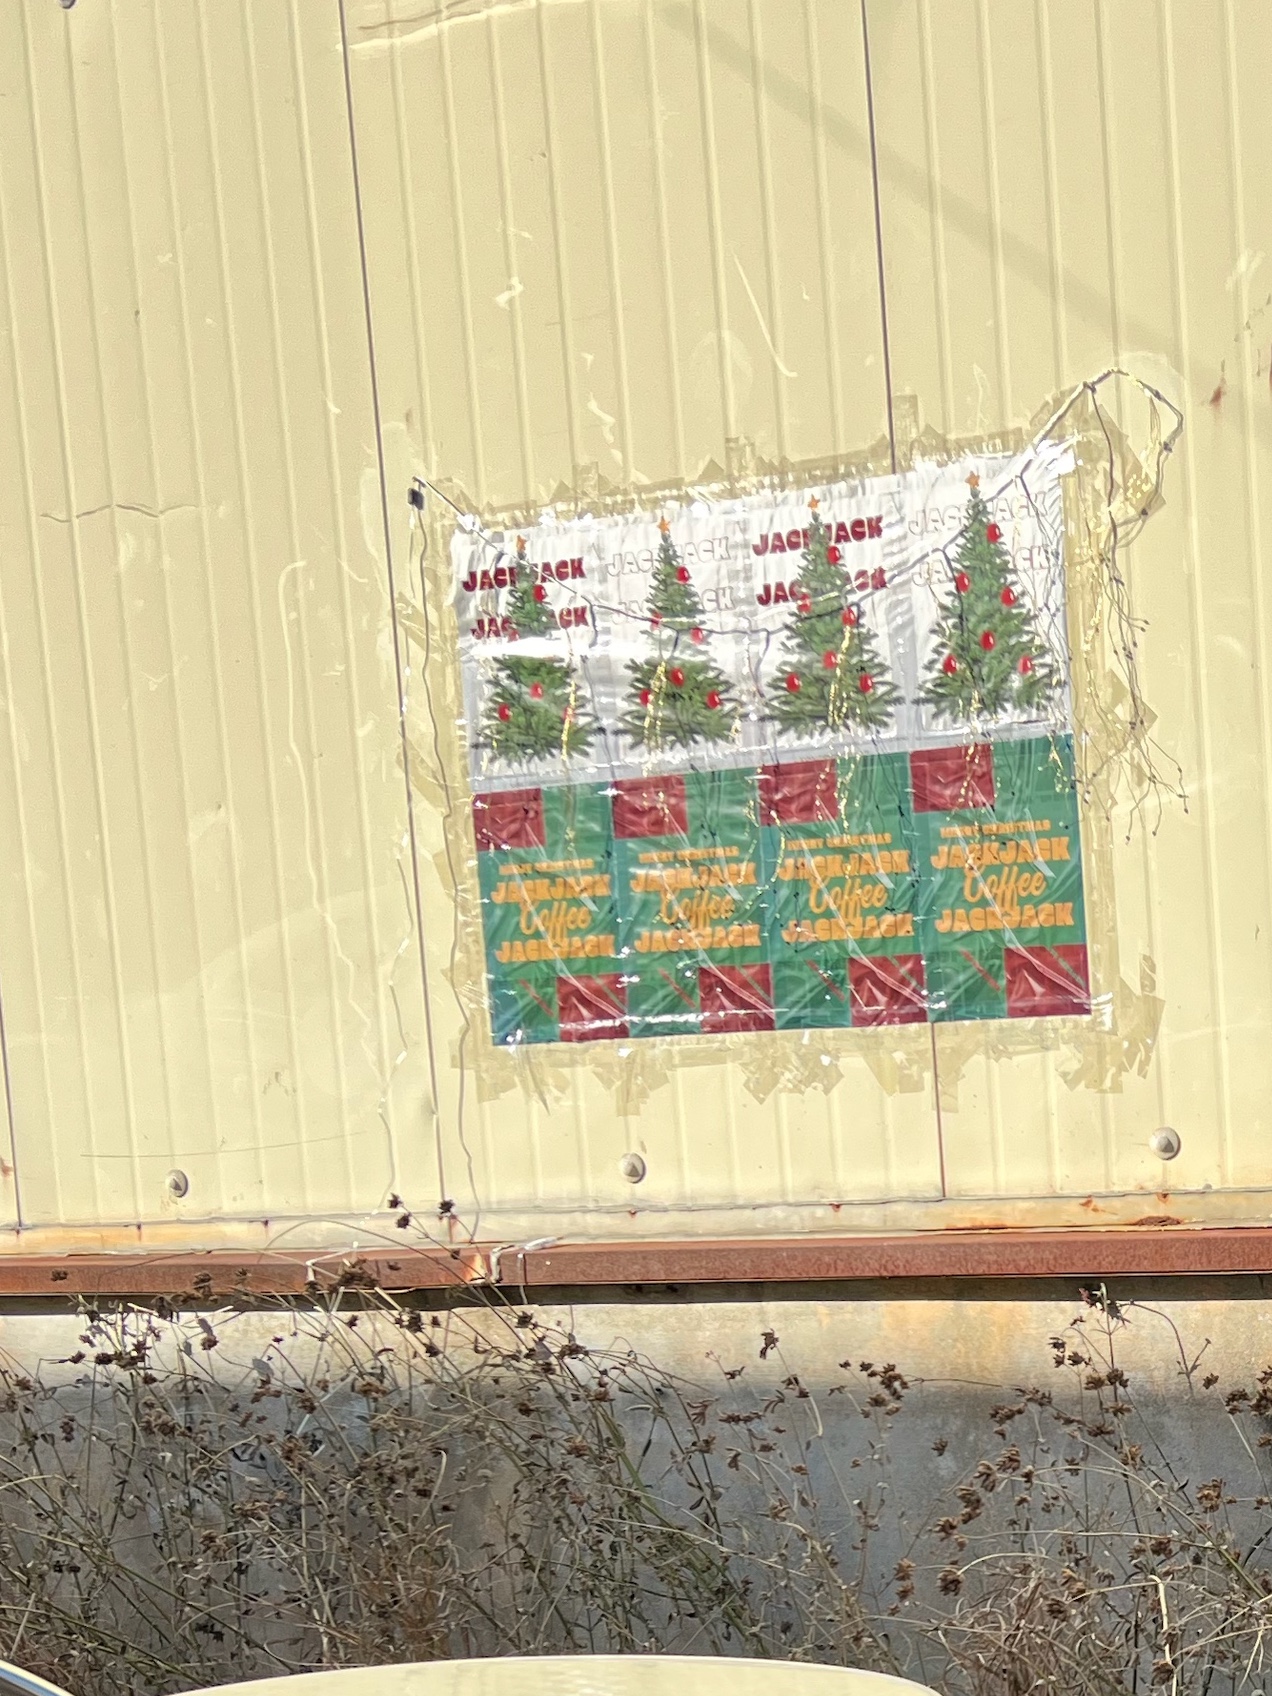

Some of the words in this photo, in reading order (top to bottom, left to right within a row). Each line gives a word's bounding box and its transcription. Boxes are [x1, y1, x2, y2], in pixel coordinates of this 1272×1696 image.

[808, 874, 888, 918] Coffee
[963, 864, 1047, 912] Coffee
[518, 896, 592, 943] Coffee
[935, 902, 1075, 933] JACKJACK
